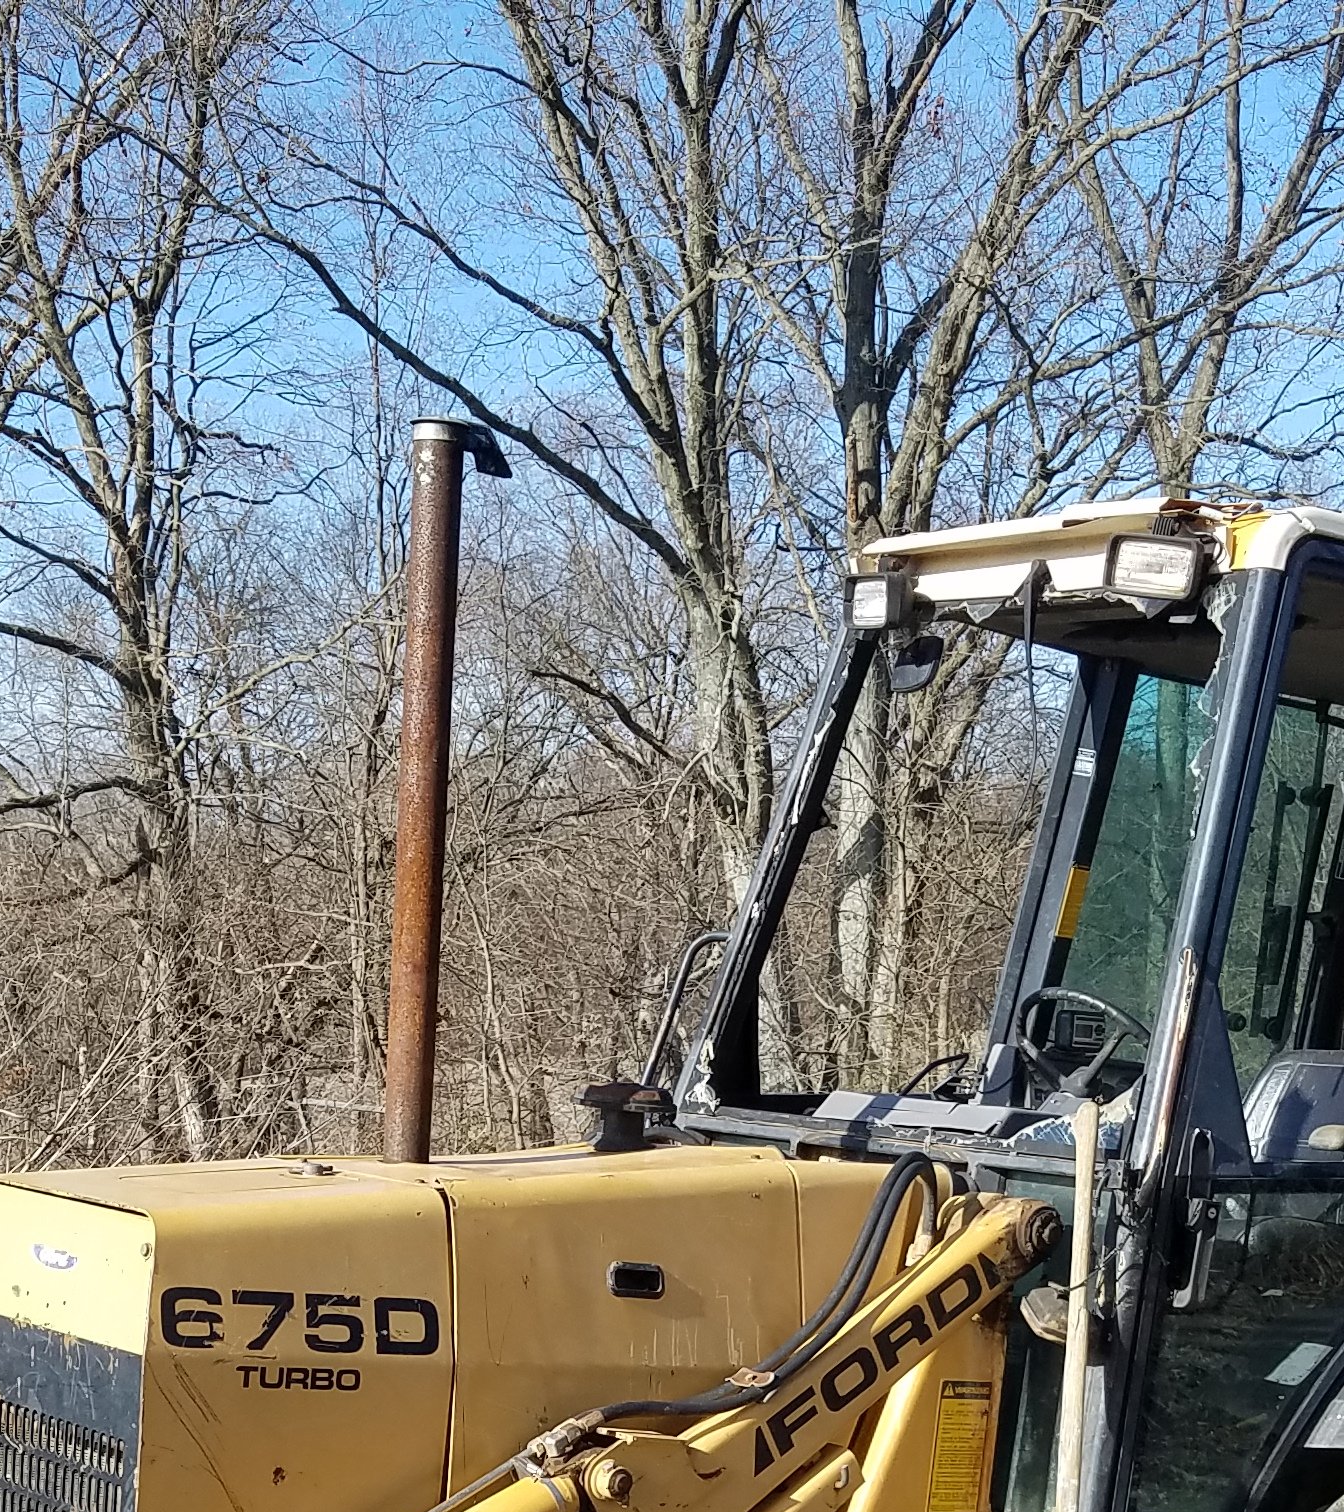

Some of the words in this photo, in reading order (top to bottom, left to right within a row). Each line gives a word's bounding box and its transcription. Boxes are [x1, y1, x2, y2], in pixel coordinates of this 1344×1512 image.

[161, 1288, 440, 1356] 675D
[236, 1366, 362, 1391] TURBO
[766, 1264, 982, 1456] FORD
